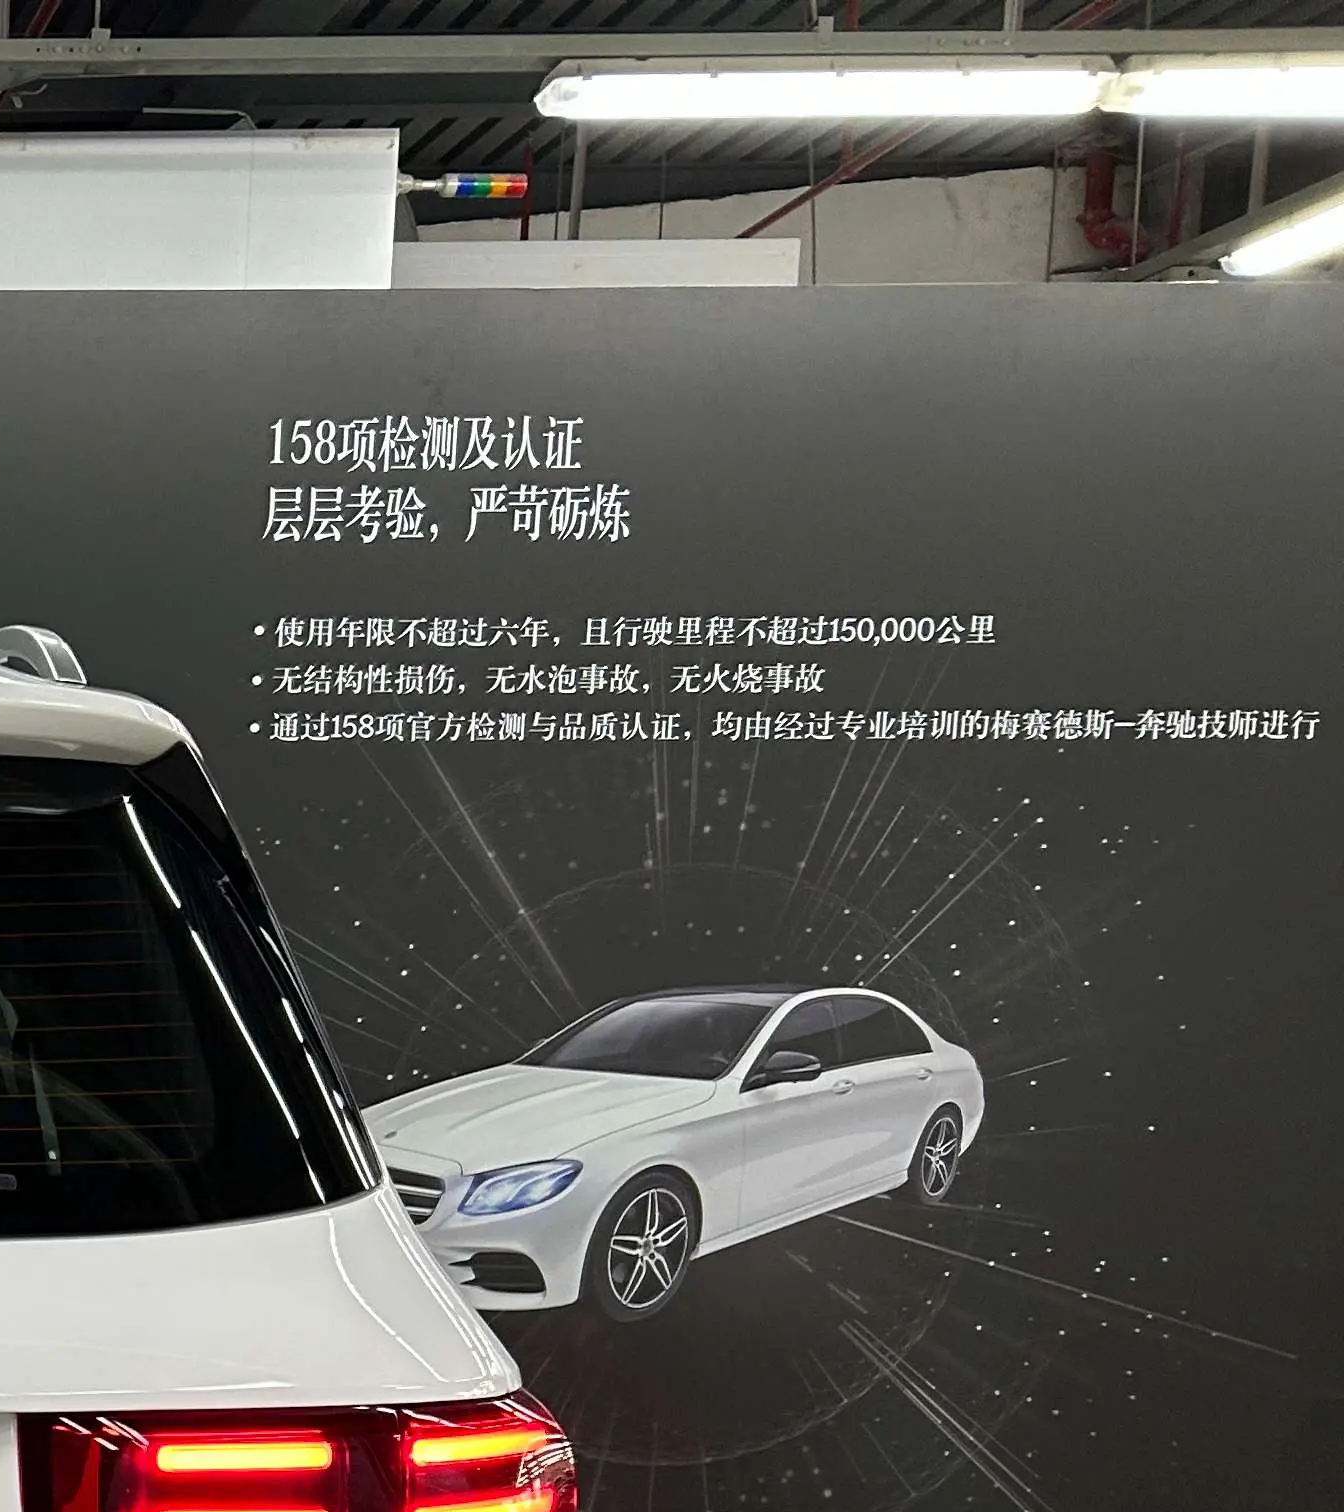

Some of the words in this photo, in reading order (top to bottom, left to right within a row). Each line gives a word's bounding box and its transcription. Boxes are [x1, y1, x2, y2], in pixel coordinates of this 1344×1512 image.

[270, 415, 583, 472] 158项检测及认证
[263, 484, 630, 543] 层层考验，严苛砺炼
[273, 663, 825, 694] 无结构性损伤，无水泡事故，无火烧事故
